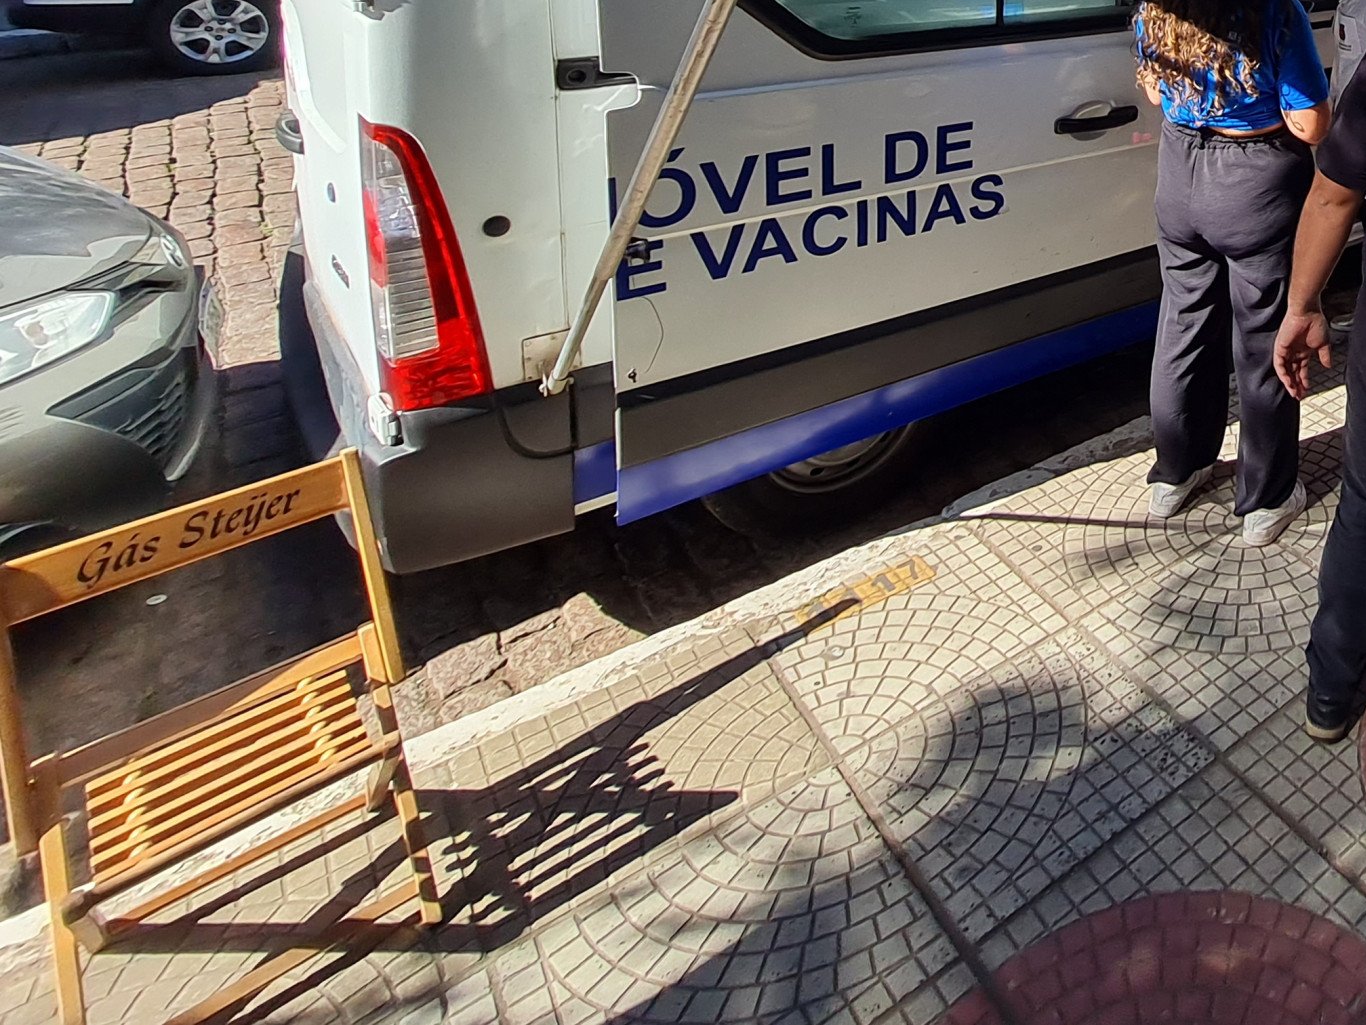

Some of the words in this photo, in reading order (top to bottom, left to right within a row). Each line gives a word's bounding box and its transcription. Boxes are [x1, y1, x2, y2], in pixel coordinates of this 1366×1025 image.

[608, 146, 863, 229] ÓVEL
[884, 121, 974, 185] DE
[690, 174, 1006, 281] VACINAS
[76, 532, 159, 590] Gás
